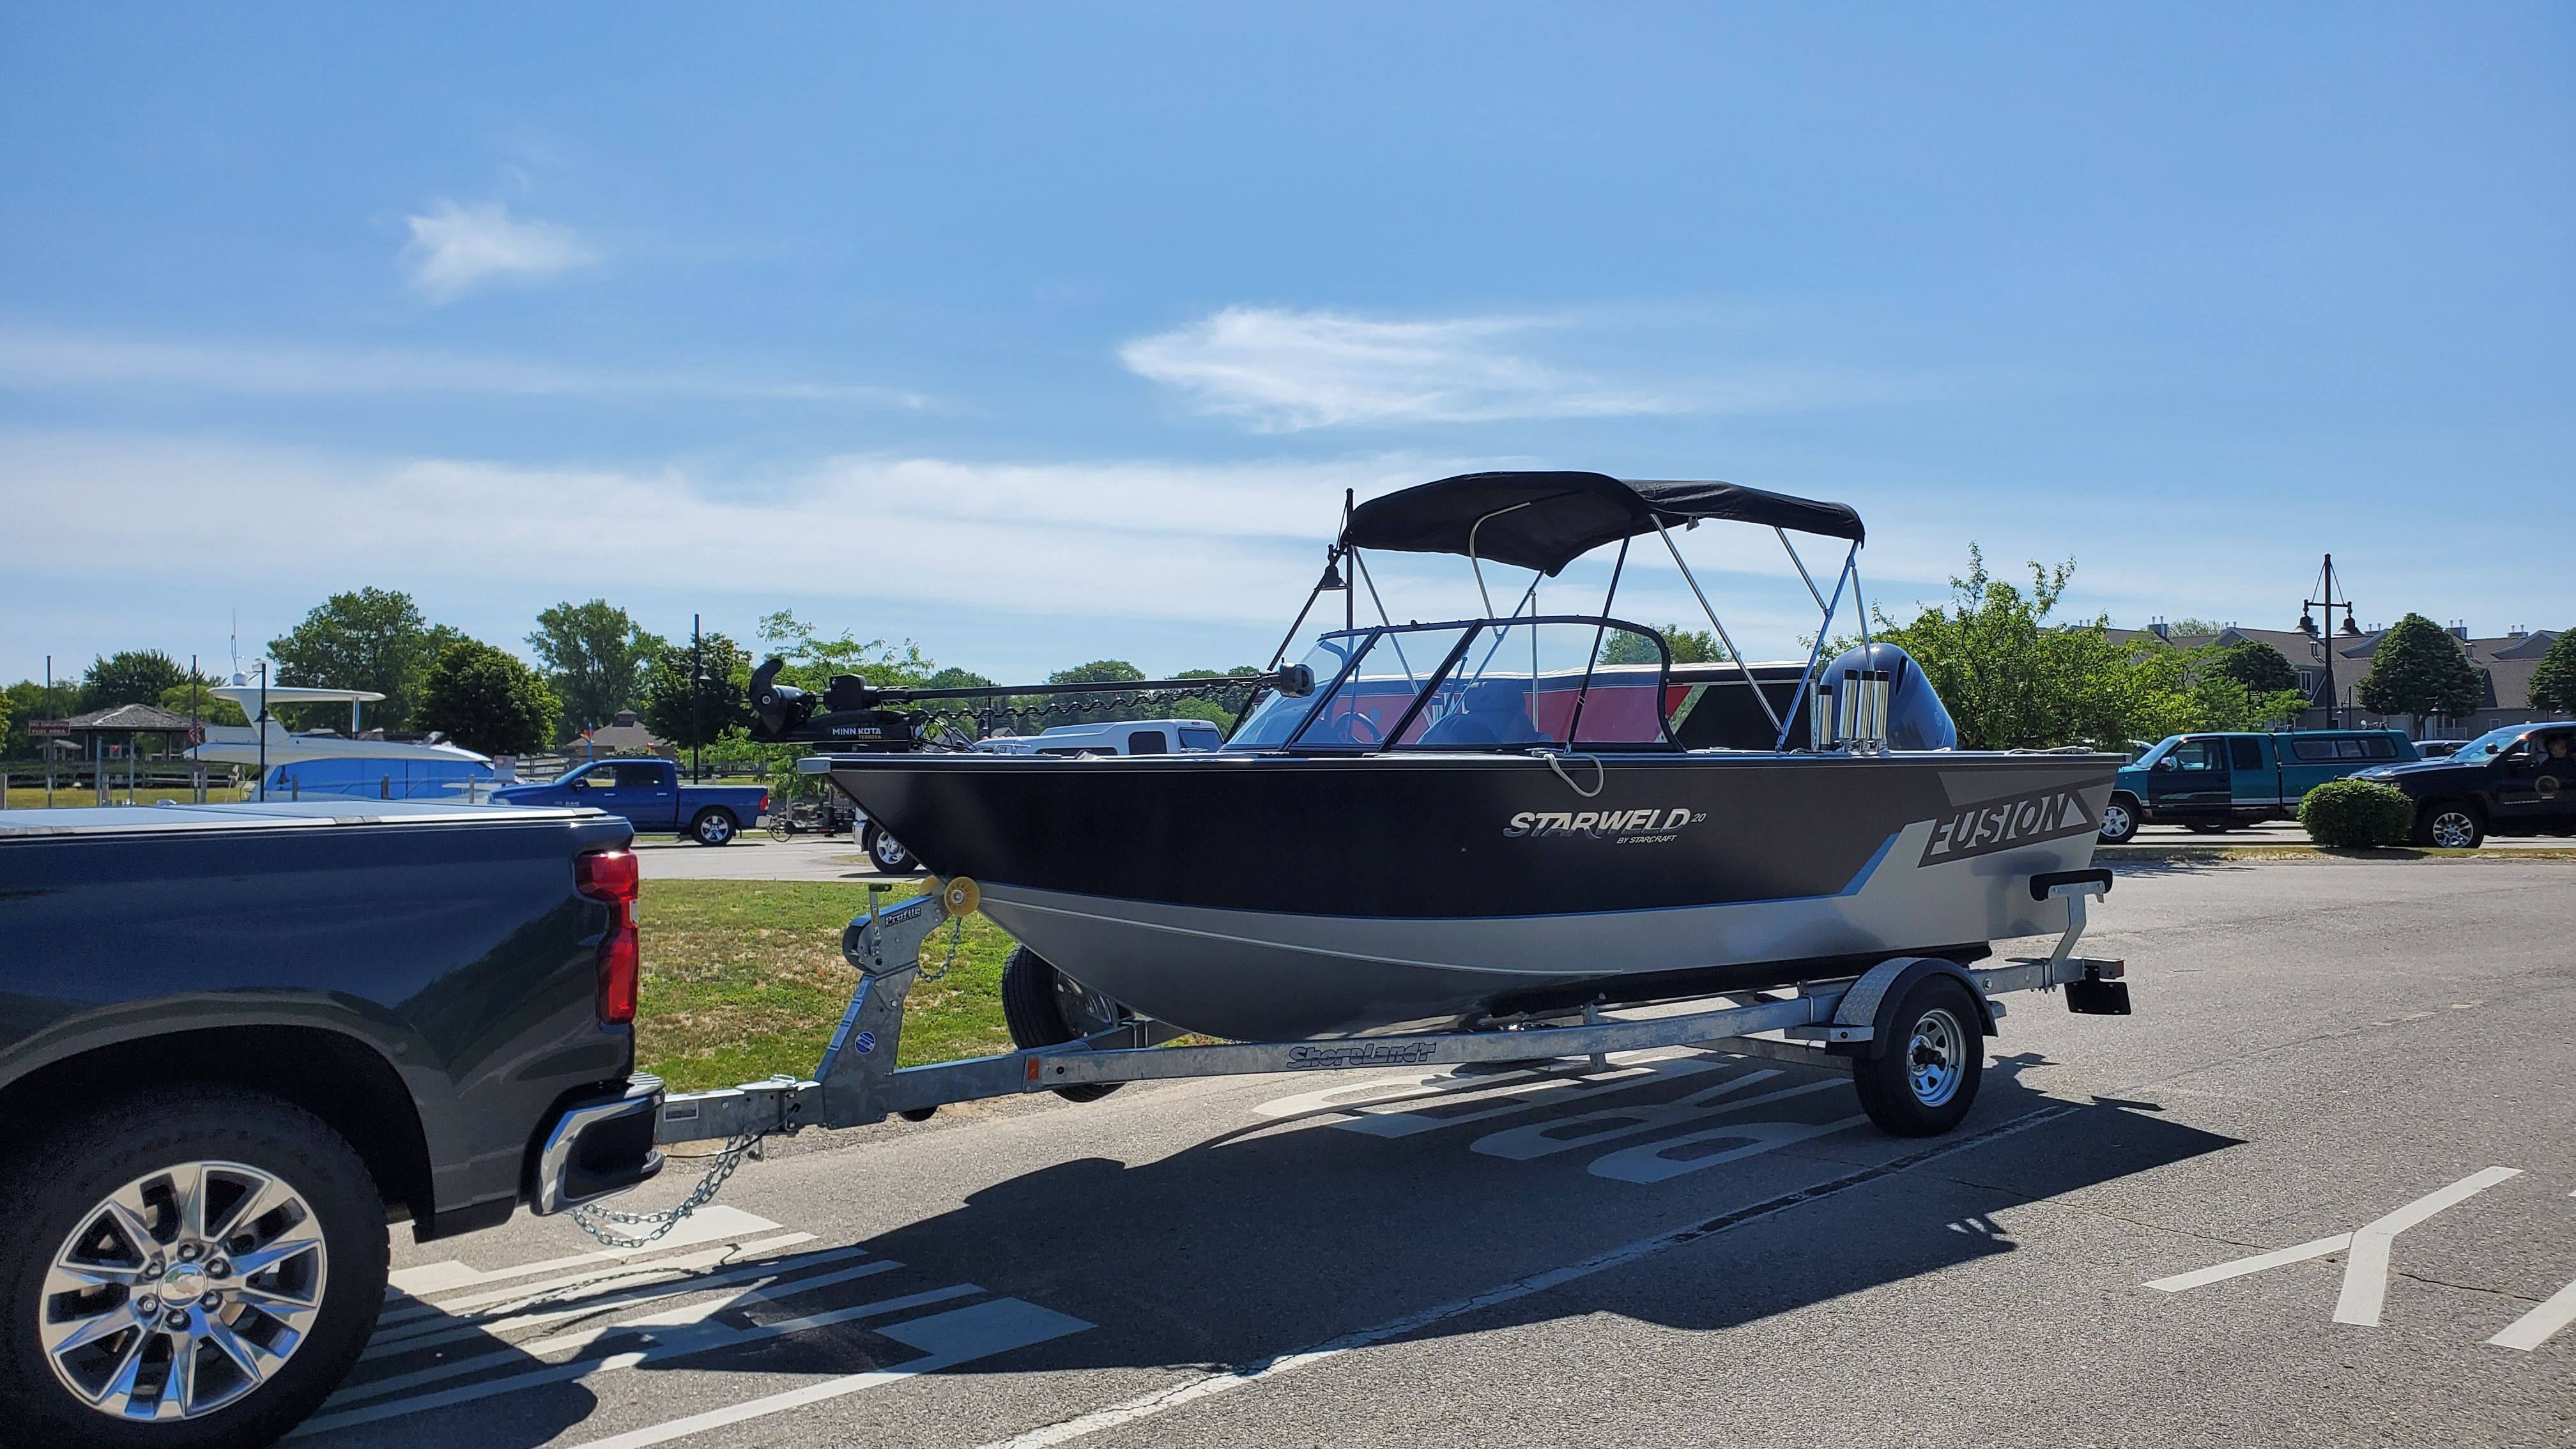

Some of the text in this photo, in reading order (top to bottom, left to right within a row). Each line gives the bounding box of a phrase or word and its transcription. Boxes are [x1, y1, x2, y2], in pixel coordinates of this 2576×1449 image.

[1503, 808, 1707, 839] STARWELD 20
[1922, 791, 2084, 864] FUSION
[1629, 835, 1677, 844] STARCRAFT
[885, 907, 921, 926] Profile
